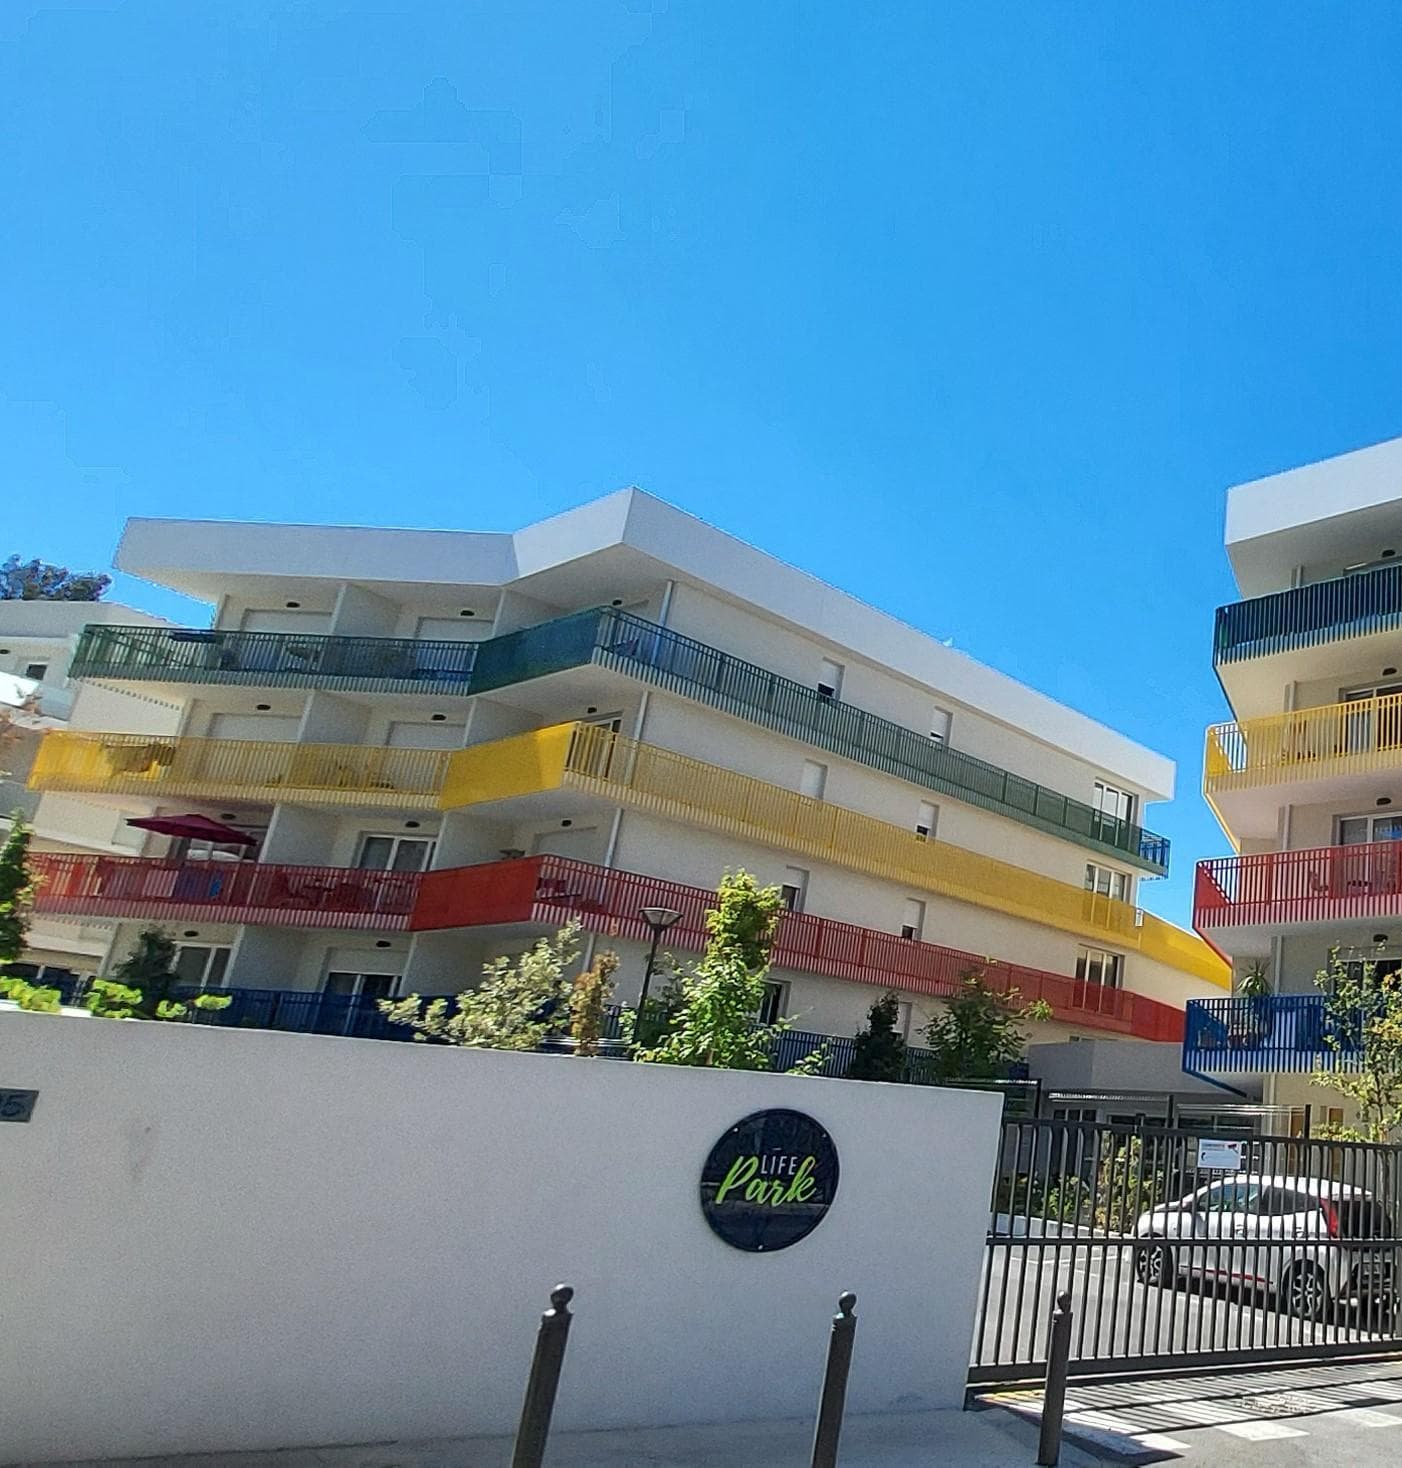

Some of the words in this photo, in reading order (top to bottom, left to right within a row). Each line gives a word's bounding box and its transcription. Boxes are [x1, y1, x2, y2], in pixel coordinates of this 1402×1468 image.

[0, 1094, 27, 1117] 5
[760, 1154, 798, 1175] LIFE
[715, 1155, 817, 1207] Park
